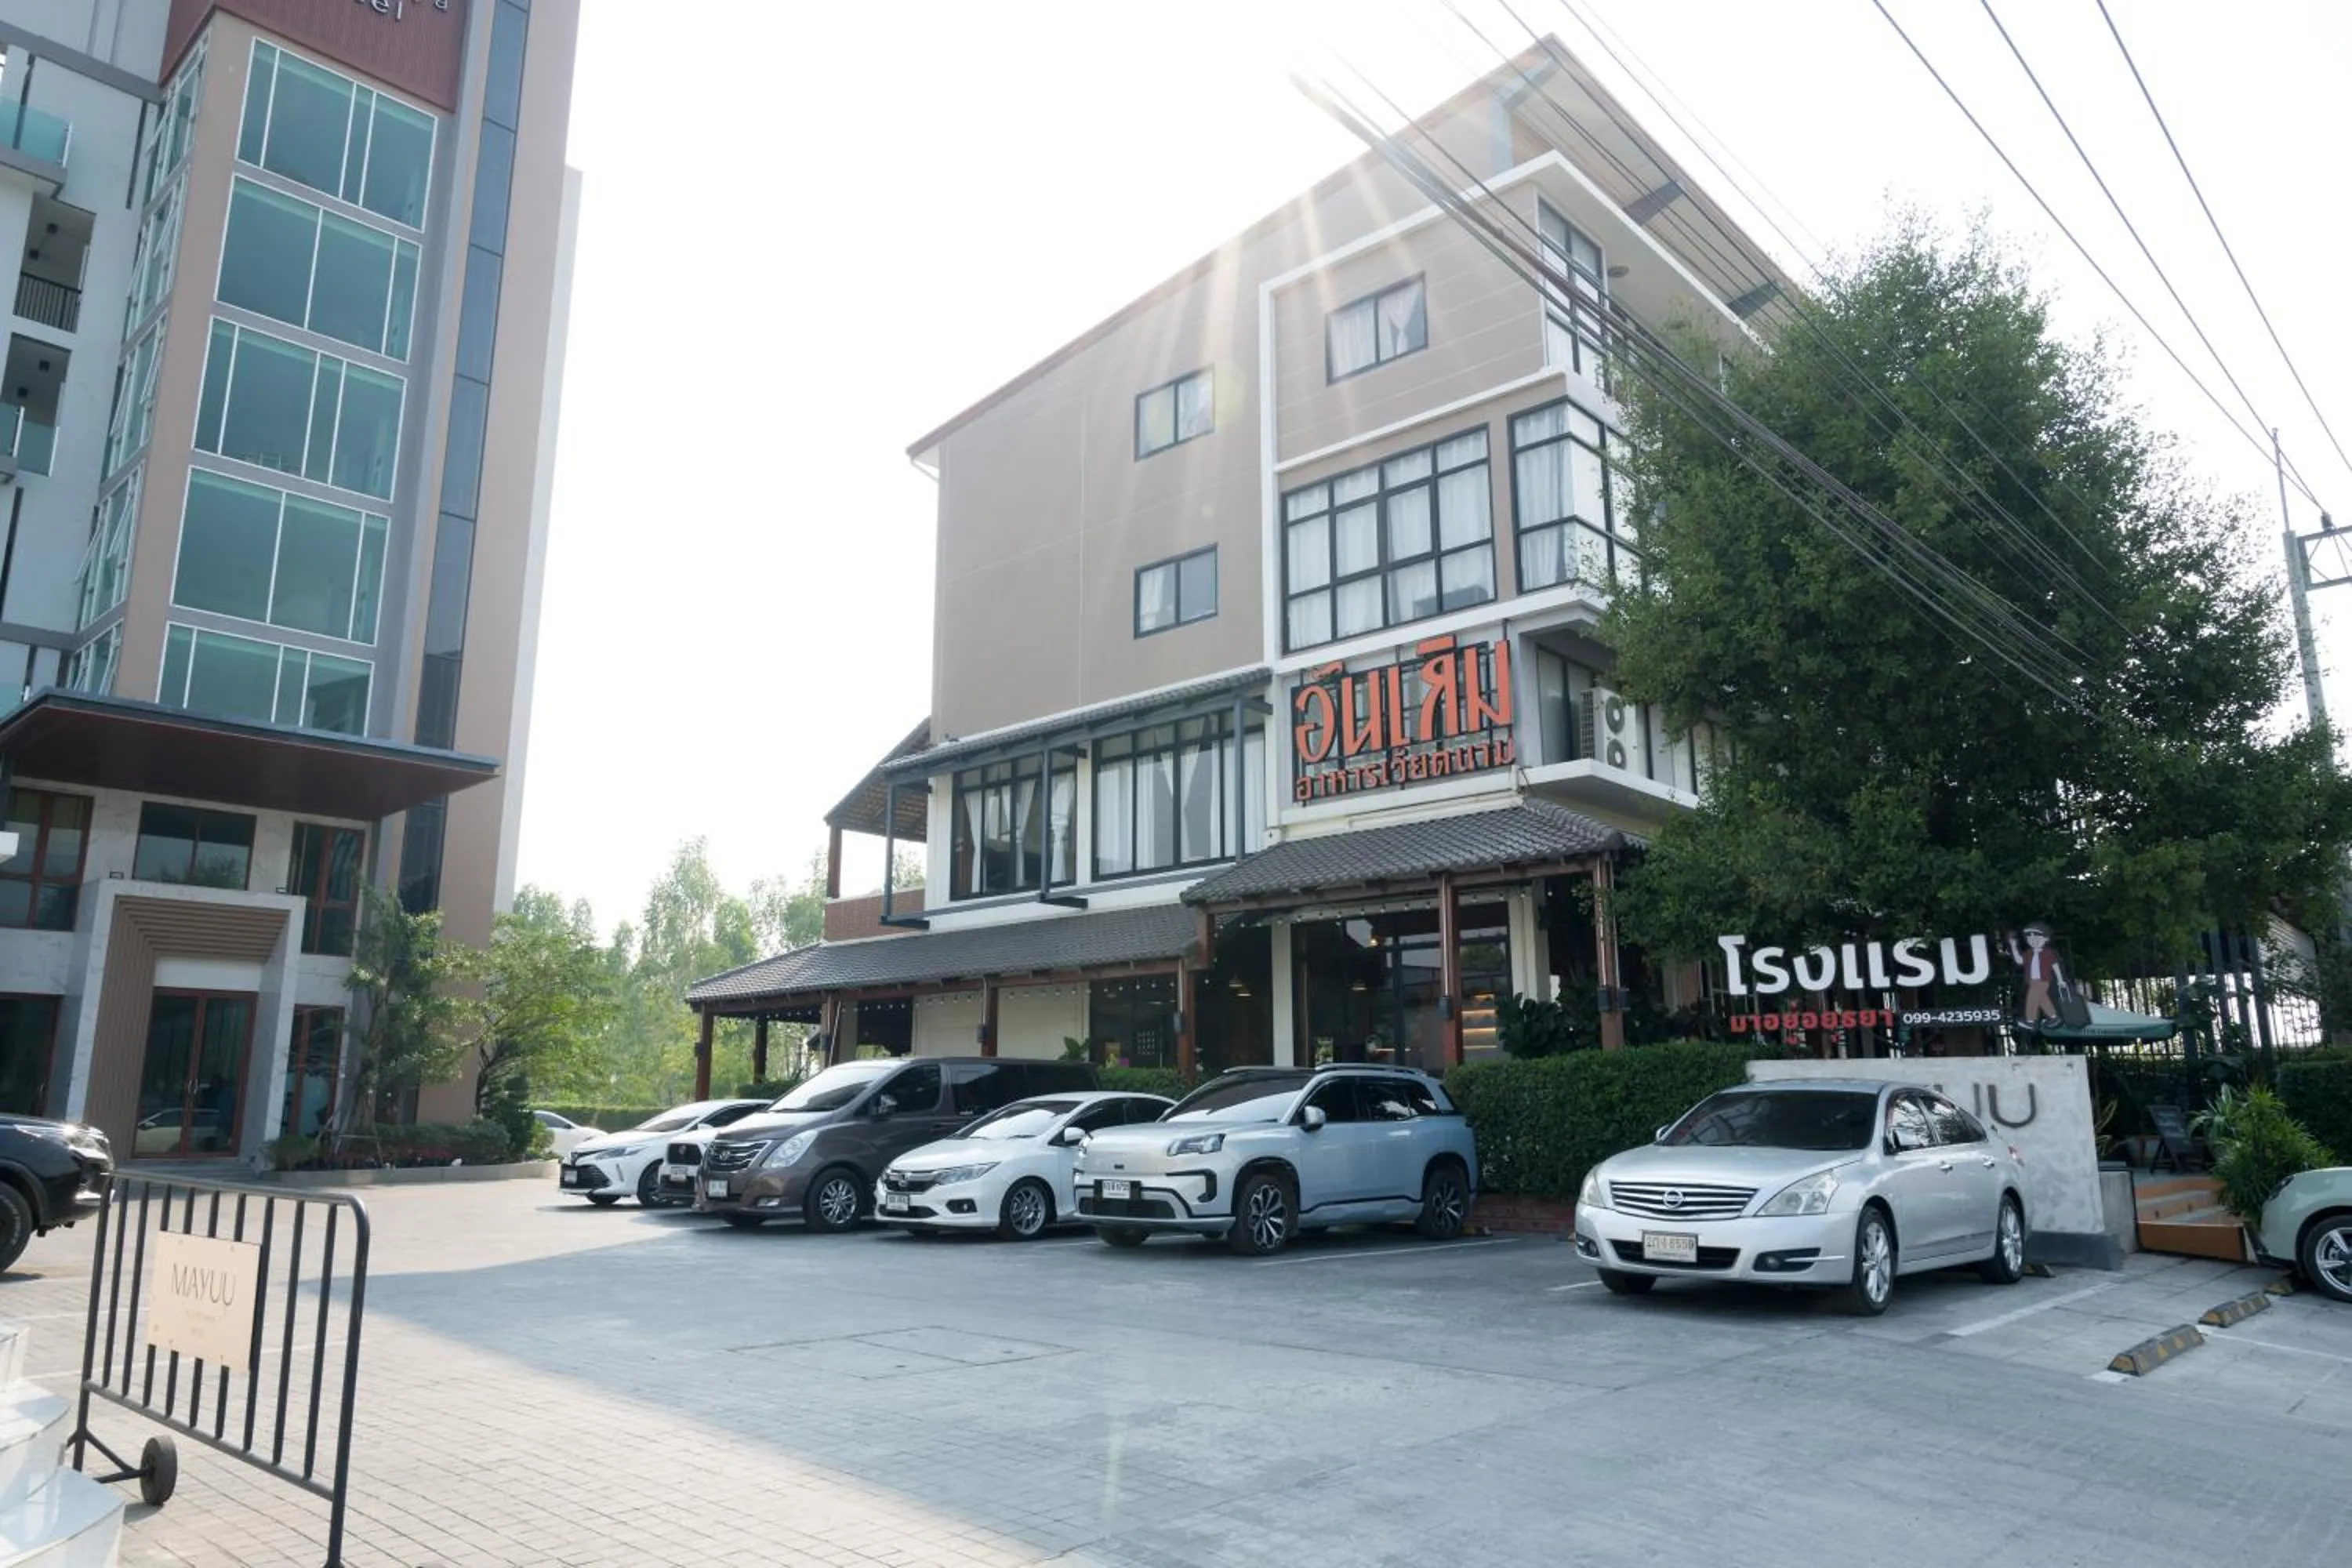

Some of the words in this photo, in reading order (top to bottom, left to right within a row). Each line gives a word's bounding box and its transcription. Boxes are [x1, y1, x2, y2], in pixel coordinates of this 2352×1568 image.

[1296, 738, 1516, 800] อาหารเวียดนาม
[1717, 934, 1991, 996] โรงแรม
[1730, 998, 1894, 1045] มาอยู่อยุธยา
[1903, 1009, 2001, 1025] 099-4235935
[170, 1262, 237, 1306] MAYUU
